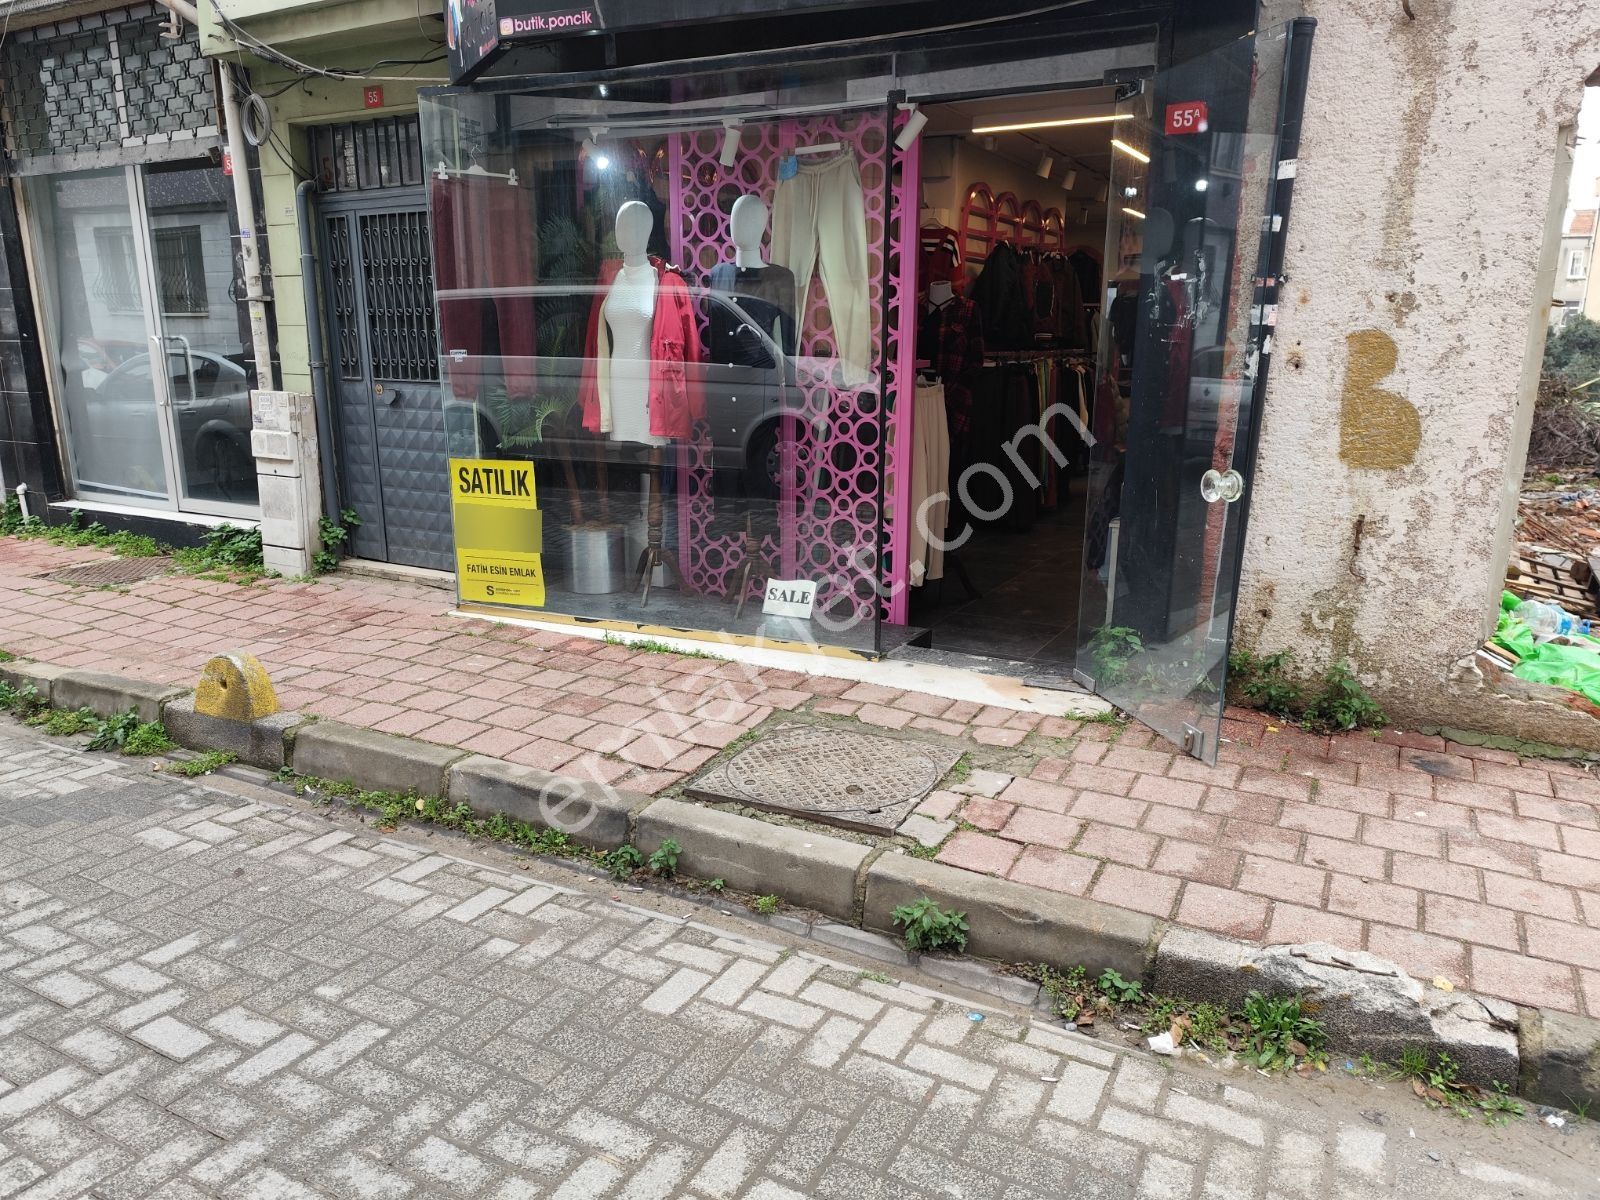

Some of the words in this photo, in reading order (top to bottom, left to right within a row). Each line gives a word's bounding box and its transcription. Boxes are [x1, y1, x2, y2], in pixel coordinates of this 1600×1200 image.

[514, 10, 593, 32] butik.poncik
[368, 91, 378, 103] 55
[458, 466, 530, 497] SATILIK
[466, 563, 488, 574] FATİH
[509, 567, 537, 578] EMLAK
[768, 587, 811, 605] SALE
